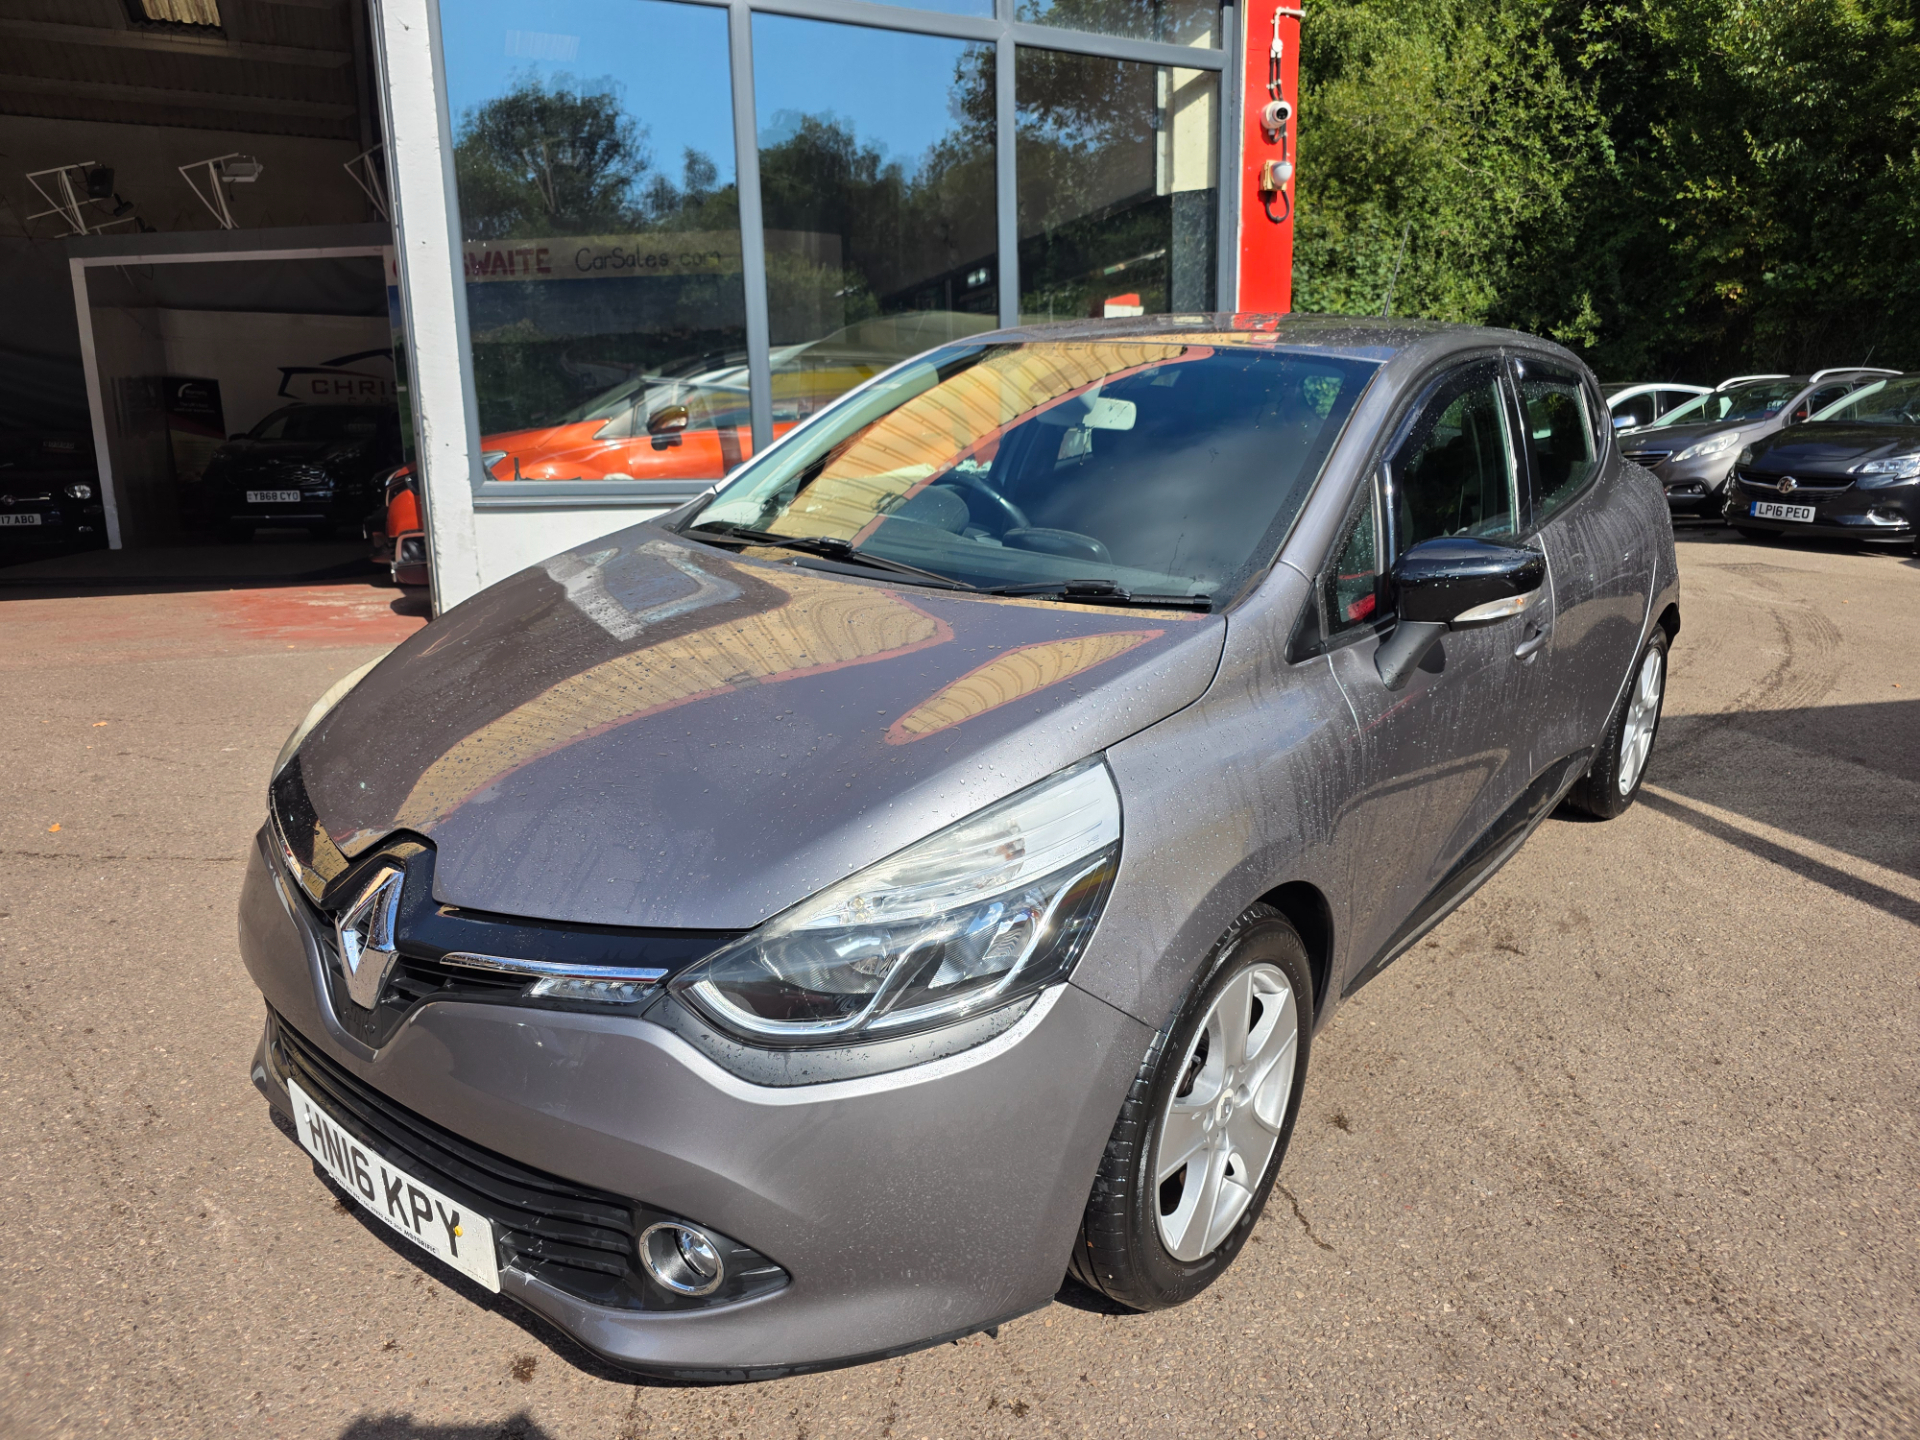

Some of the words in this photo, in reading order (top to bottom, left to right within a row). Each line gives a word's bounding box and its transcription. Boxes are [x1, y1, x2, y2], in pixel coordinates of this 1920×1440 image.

[253, 491, 278, 501] YB68
[279, 491, 299, 501] CYO
[1758, 503, 1784, 517] LP16
[1785, 506, 1810, 519] PEO
[14, 514, 35, 524] ABO
[304, 1102, 375, 1202] HN16
[380, 1166, 460, 1258] KPY
